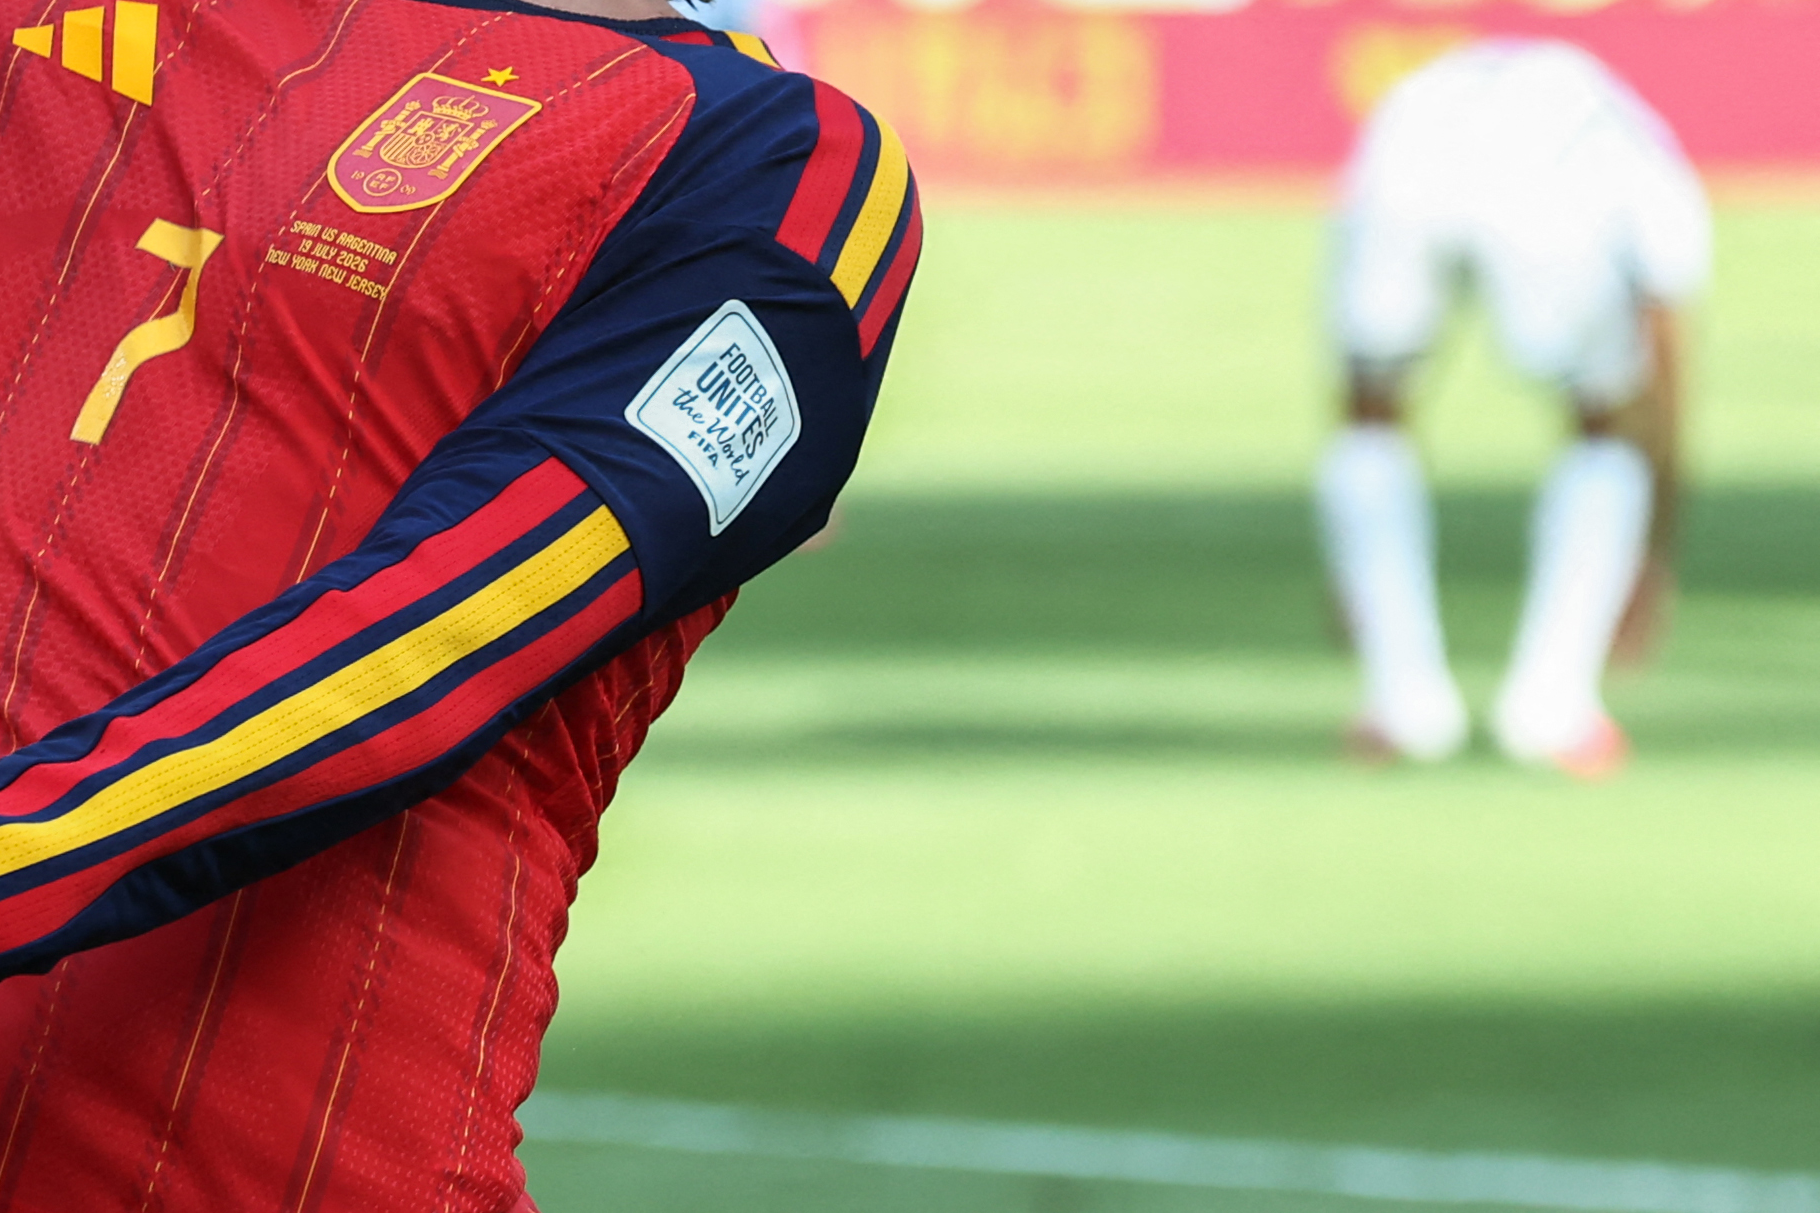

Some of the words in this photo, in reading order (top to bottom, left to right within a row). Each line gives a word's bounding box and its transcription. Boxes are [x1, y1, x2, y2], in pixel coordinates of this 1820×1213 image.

[265, 248, 291, 266] NEW
[291, 254, 319, 273] YORK
[318, 263, 347, 284] NEW
[345, 274, 388, 300] JERSEY
[290, 220, 322, 237] SPAIN
[336, 232, 397, 265] ARGENTINA
[298, 238, 313, 253] 19
[310, 243, 338, 260] JULY
[336, 250, 369, 272] 2026
[70, 218, 225, 445] 7
[696, 361, 764, 459] UNITES
[719, 342, 778, 438] FOOTBALL
[672, 387, 706, 424] the
[706, 417, 750, 486] World
[687, 430, 718, 468] FIFA
